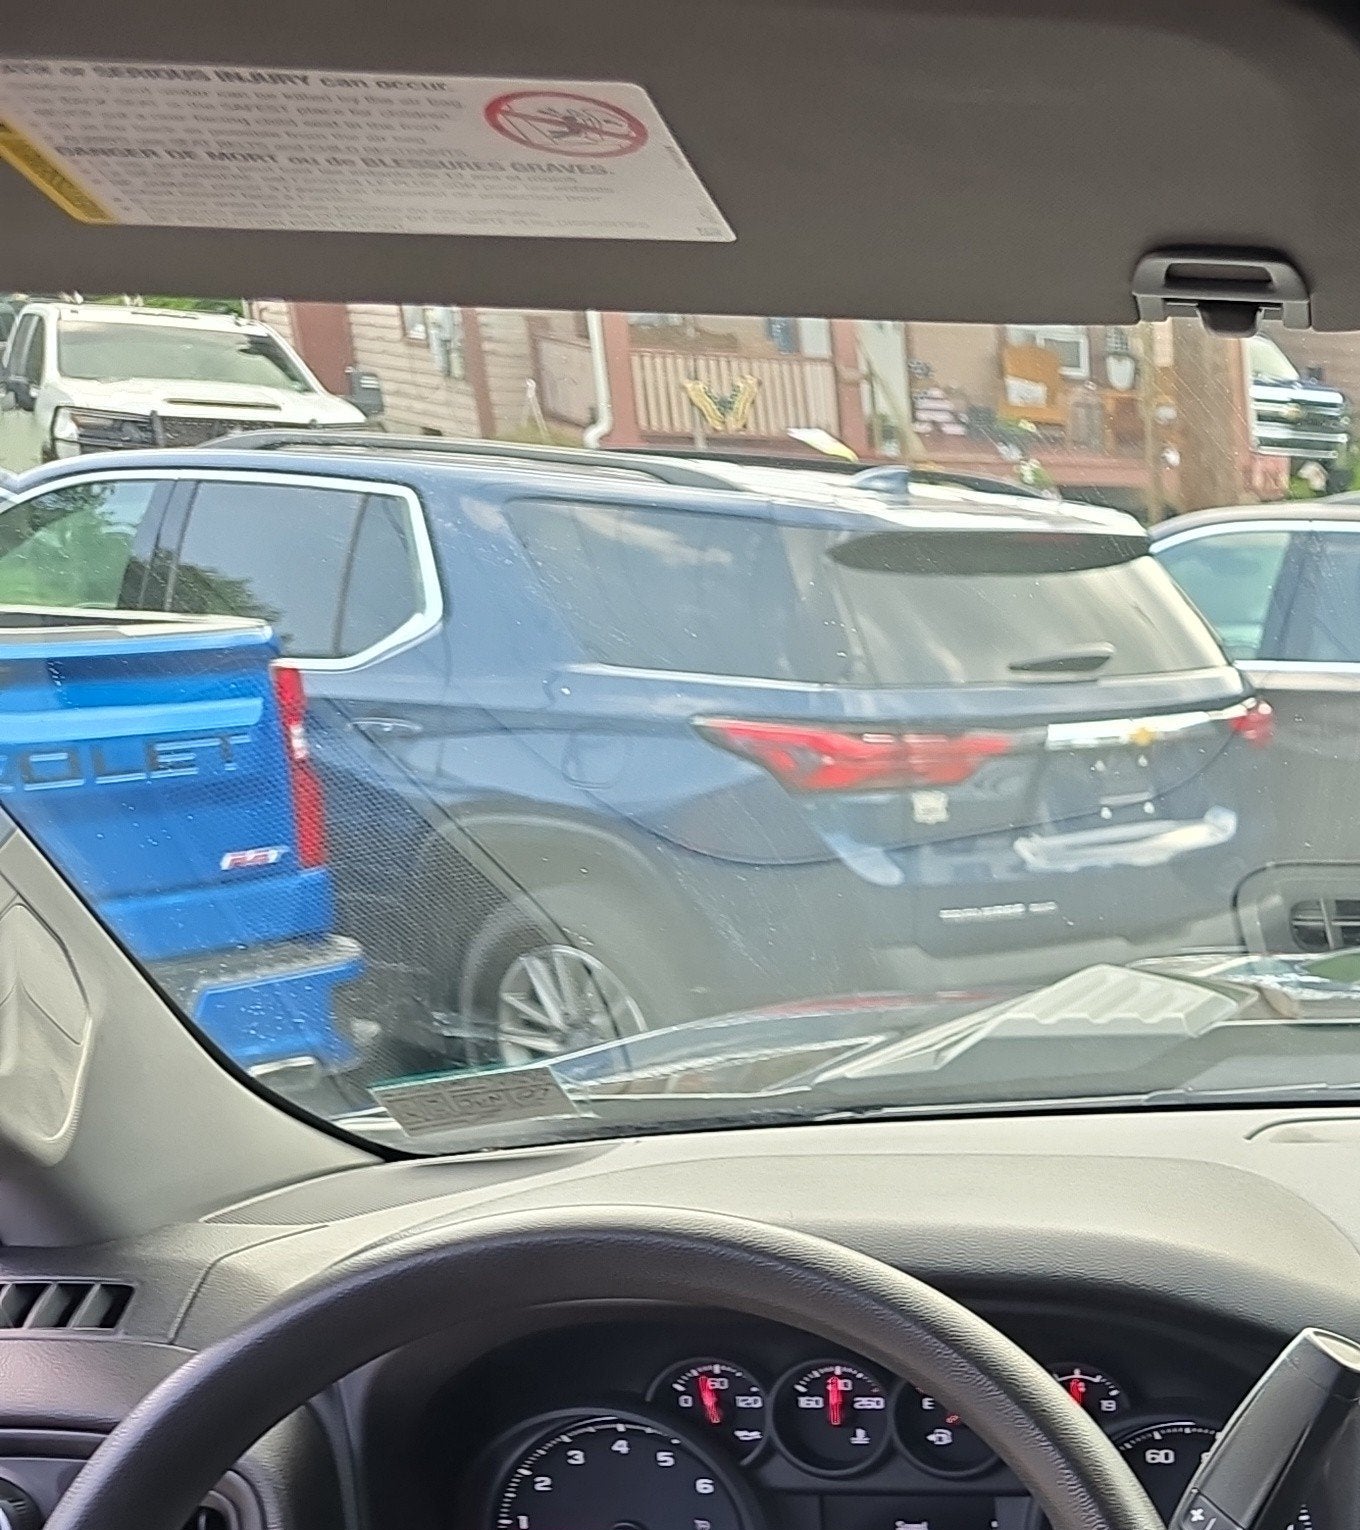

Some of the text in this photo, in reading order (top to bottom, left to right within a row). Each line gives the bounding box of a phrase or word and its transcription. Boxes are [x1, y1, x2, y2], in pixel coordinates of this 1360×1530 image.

[0, 734, 251, 793] OLET
[735, 1394, 763, 1409] 120
[796, 1395, 825, 1409] 160
[853, 1396, 886, 1409] 250
[610, 1438, 631, 1455] 4
[566, 1449, 586, 1466] 3
[655, 1451, 676, 1468] 5
[1144, 1448, 1176, 1464] 60
[533, 1476, 553, 1492] 2
[695, 1478, 716, 1495] 6
[516, 1514, 531, 1530] 1
